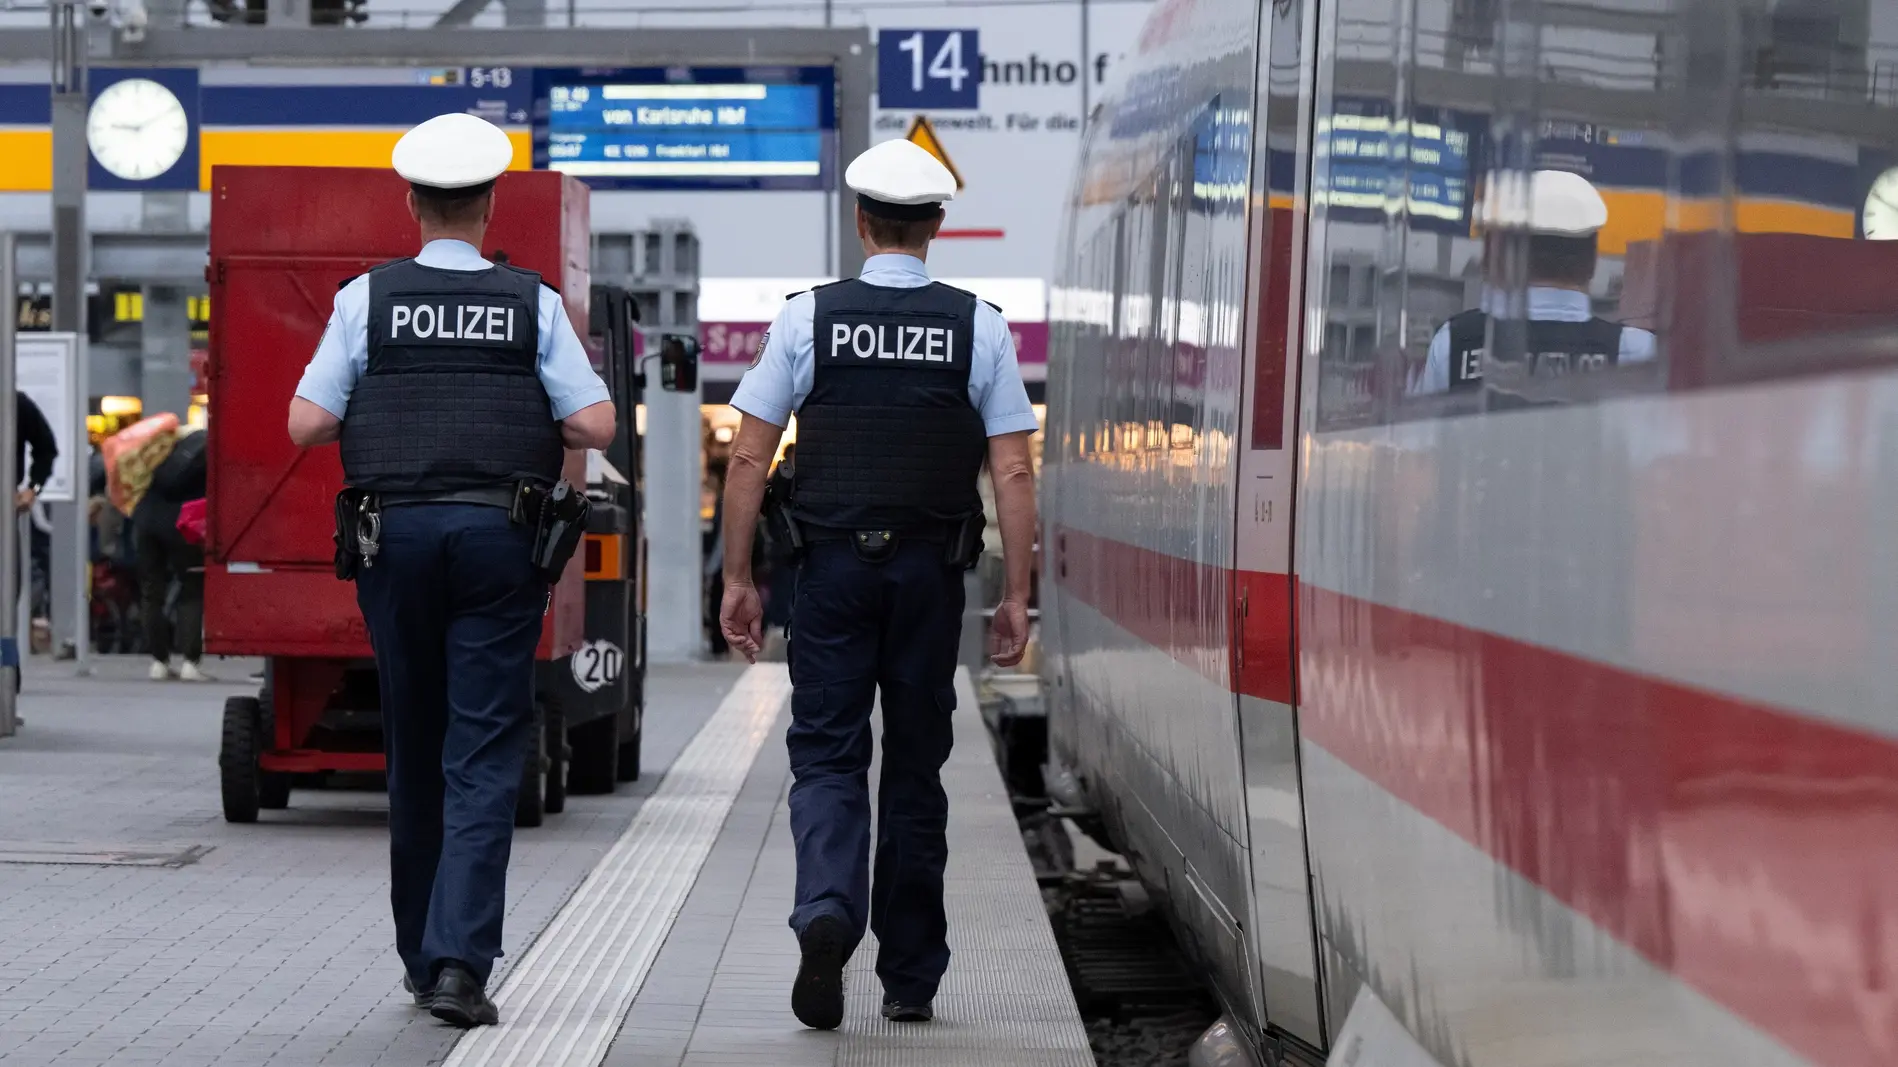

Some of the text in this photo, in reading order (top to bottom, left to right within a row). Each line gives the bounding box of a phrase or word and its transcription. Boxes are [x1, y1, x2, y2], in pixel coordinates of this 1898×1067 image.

[899, 31, 969, 92] 14
[875, 113, 1078, 130] die mwelt. Für die
[391, 304, 515, 341] POLIZEI
[831, 323, 953, 363] POLIZEI
[586, 648, 618, 682] 20
